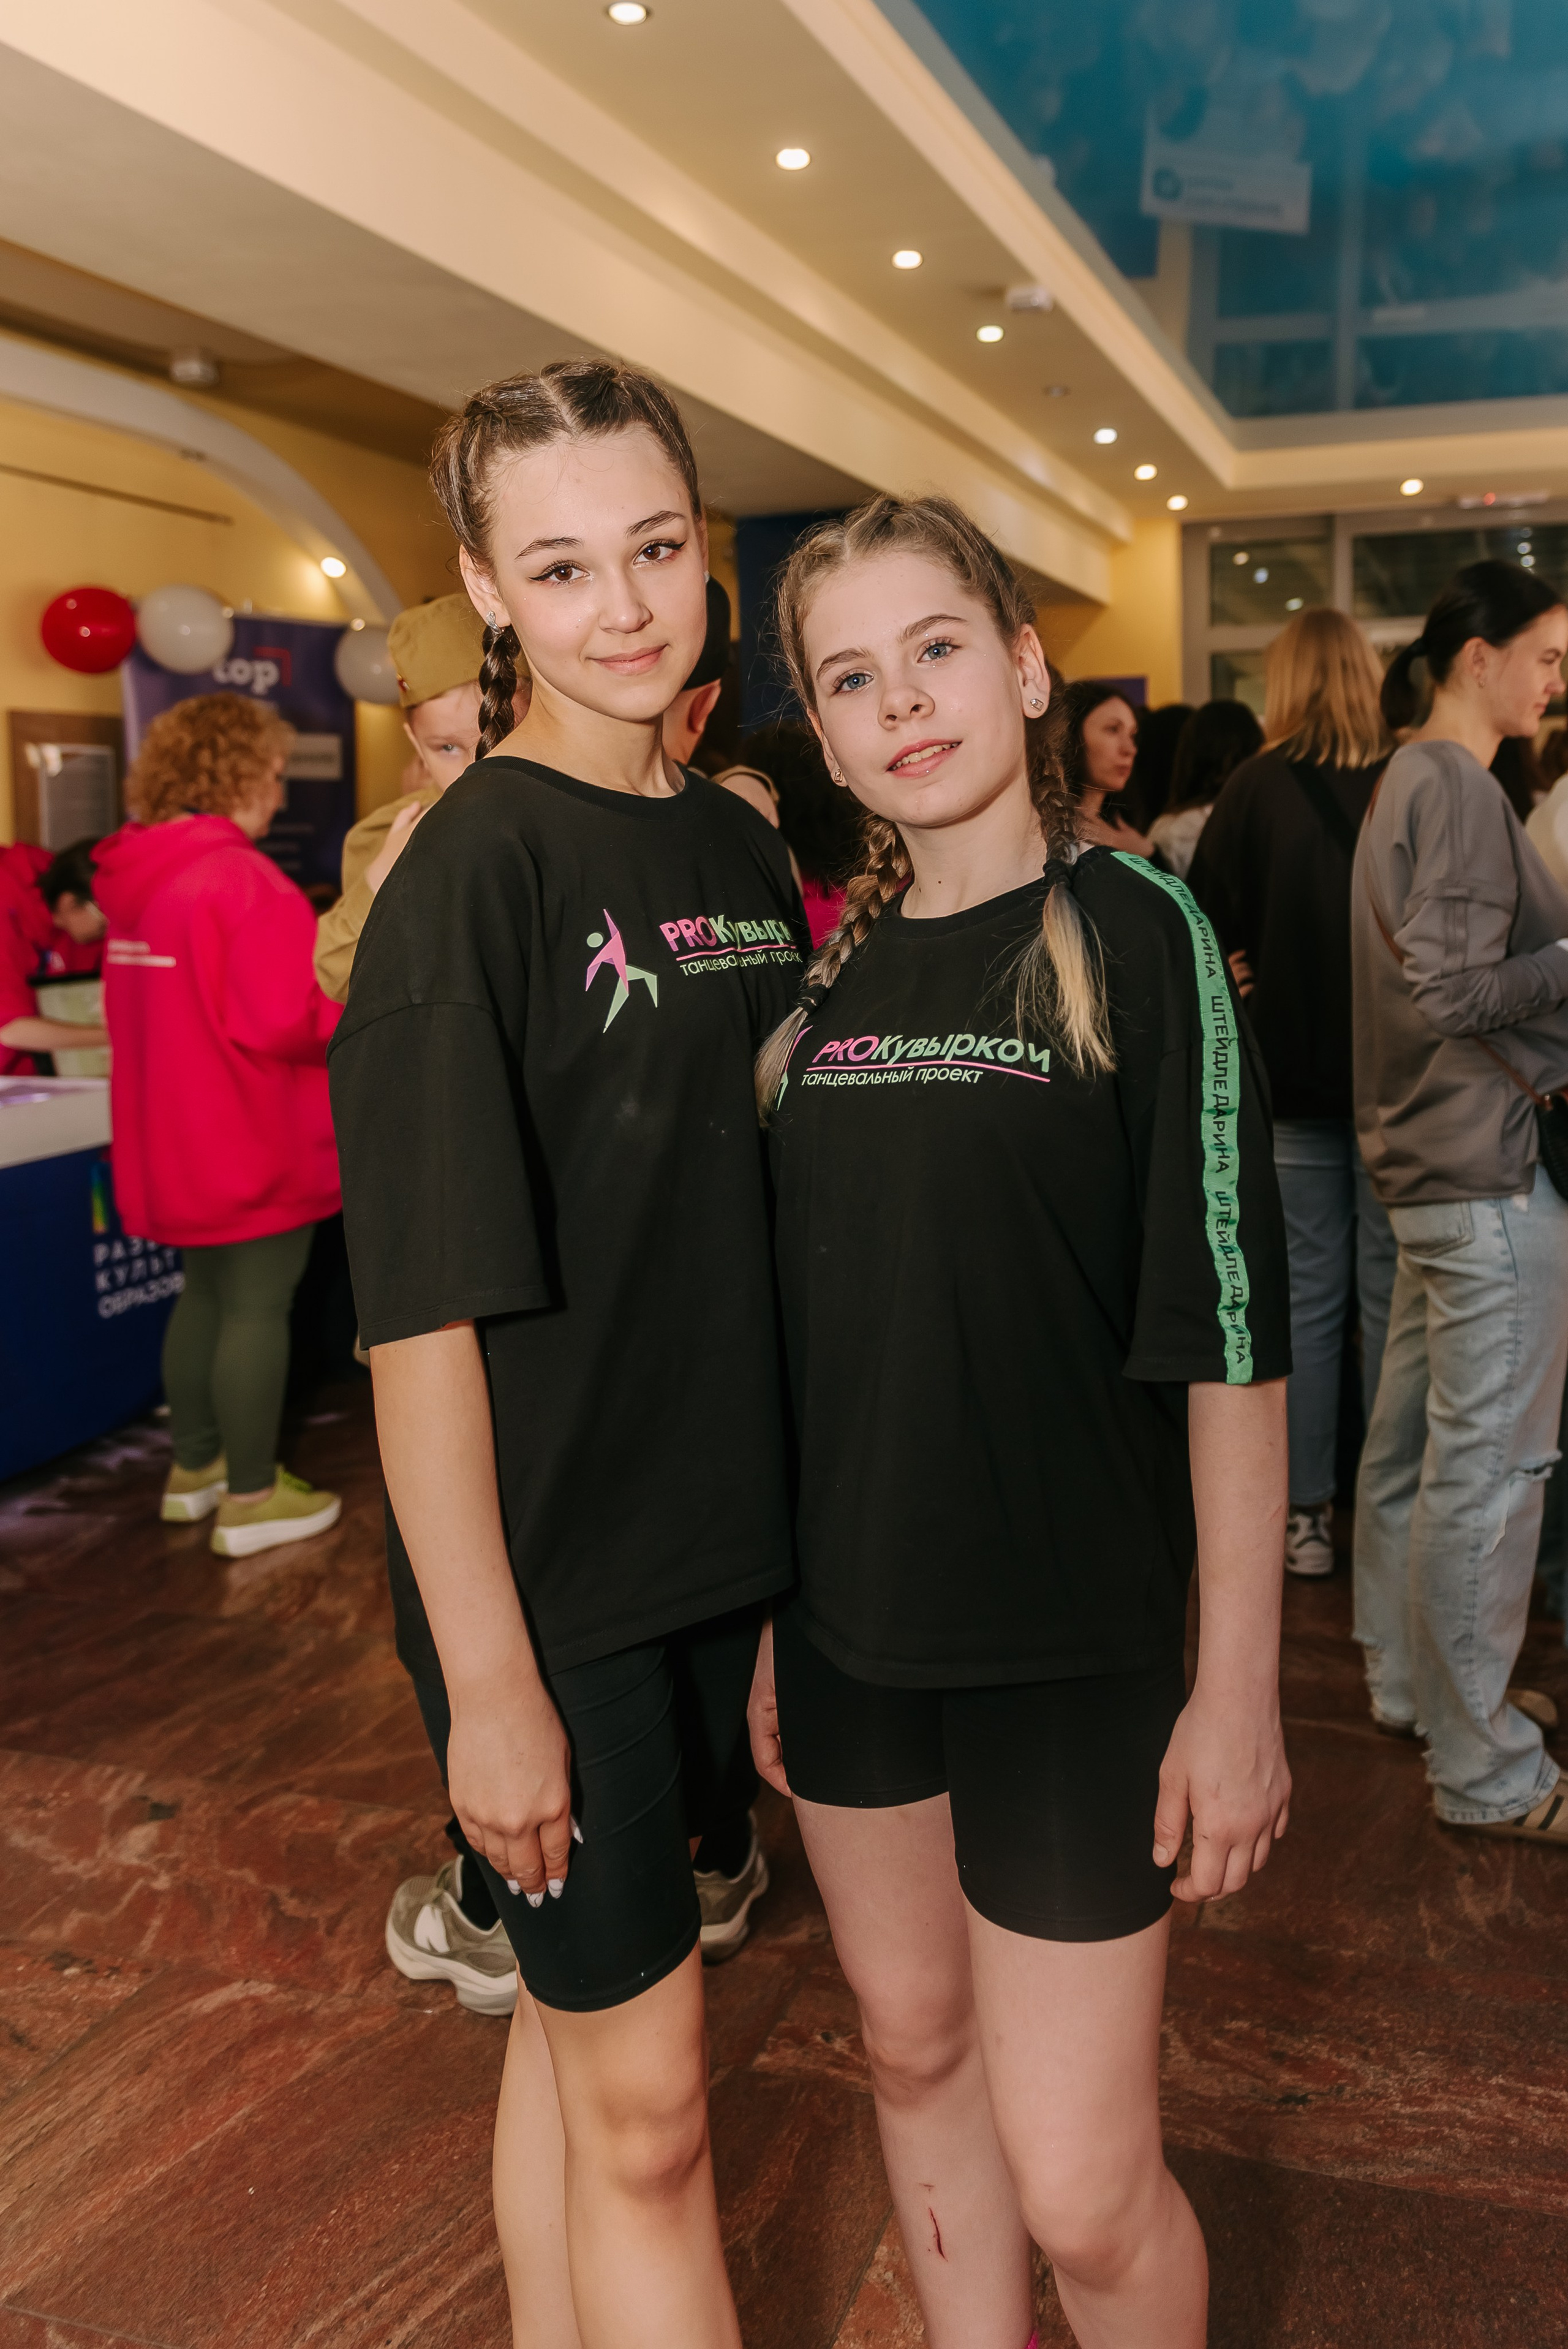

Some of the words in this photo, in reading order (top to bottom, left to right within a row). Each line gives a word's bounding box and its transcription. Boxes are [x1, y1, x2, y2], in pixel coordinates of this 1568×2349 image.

[769, 950, 804, 966] проек
[801, 1066, 914, 1087] танцевальный
[915, 1067, 984, 1084] проект
[1185, 902, 1216, 978] ДАРИНА
[1212, 1094, 1231, 1173] ДАРИНА
[1227, 1284, 1246, 1364] ДАРИНА
[96, 1247, 179, 1293] КУЛЬТ
